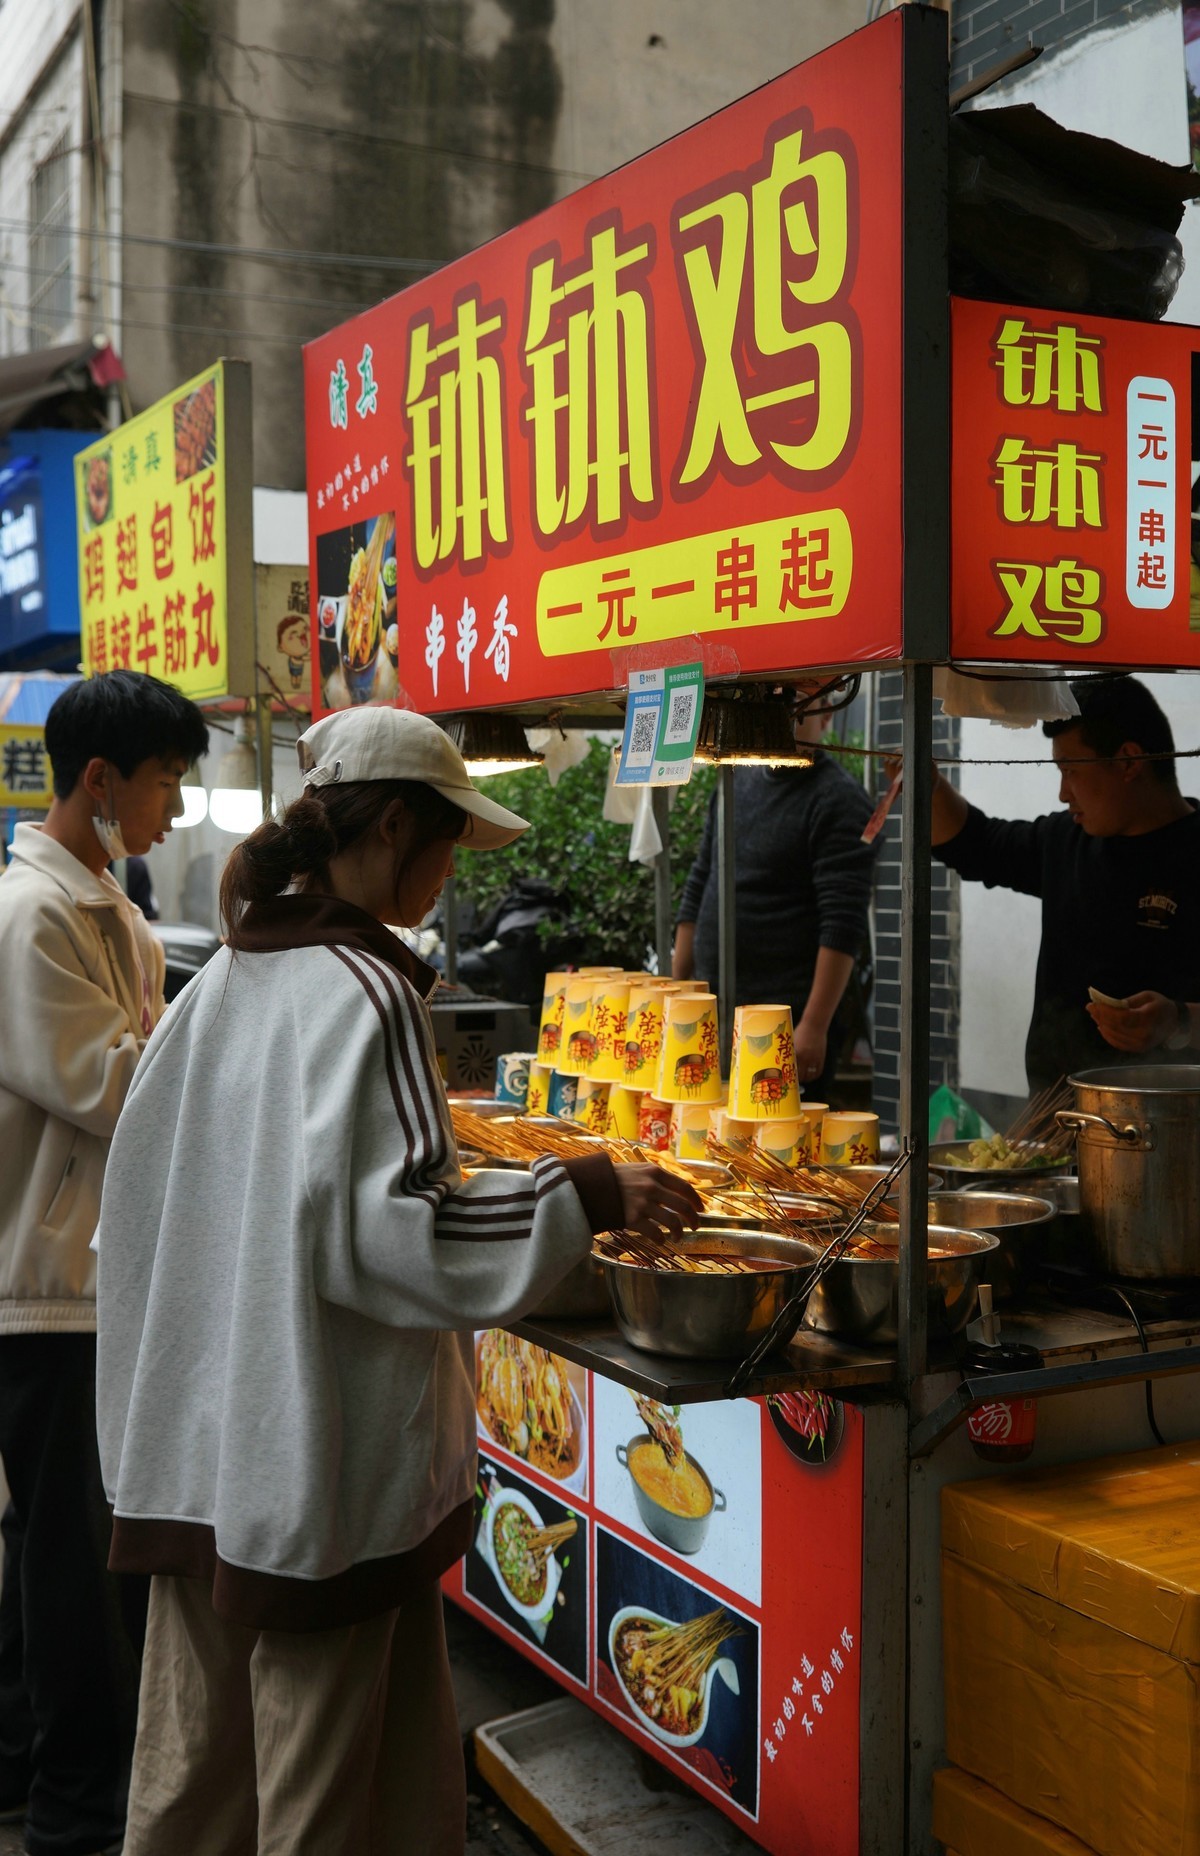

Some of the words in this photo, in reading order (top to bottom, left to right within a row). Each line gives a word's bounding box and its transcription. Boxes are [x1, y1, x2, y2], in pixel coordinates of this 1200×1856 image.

[328, 343, 379, 430] 清真
[405, 129, 853, 569] 钵钵鸡
[84, 470, 217, 607] 鸡翅包饭
[994, 318, 1102, 644] 钵钵鸡
[1136, 392, 1168, 590] 一元一串起
[547, 526, 835, 642] 一元一串起
[424, 594, 518, 697] 串串香
[764, 1653, 815, 1763] 最初的味道
[801, 1626, 854, 1738] 不舍的情怀
